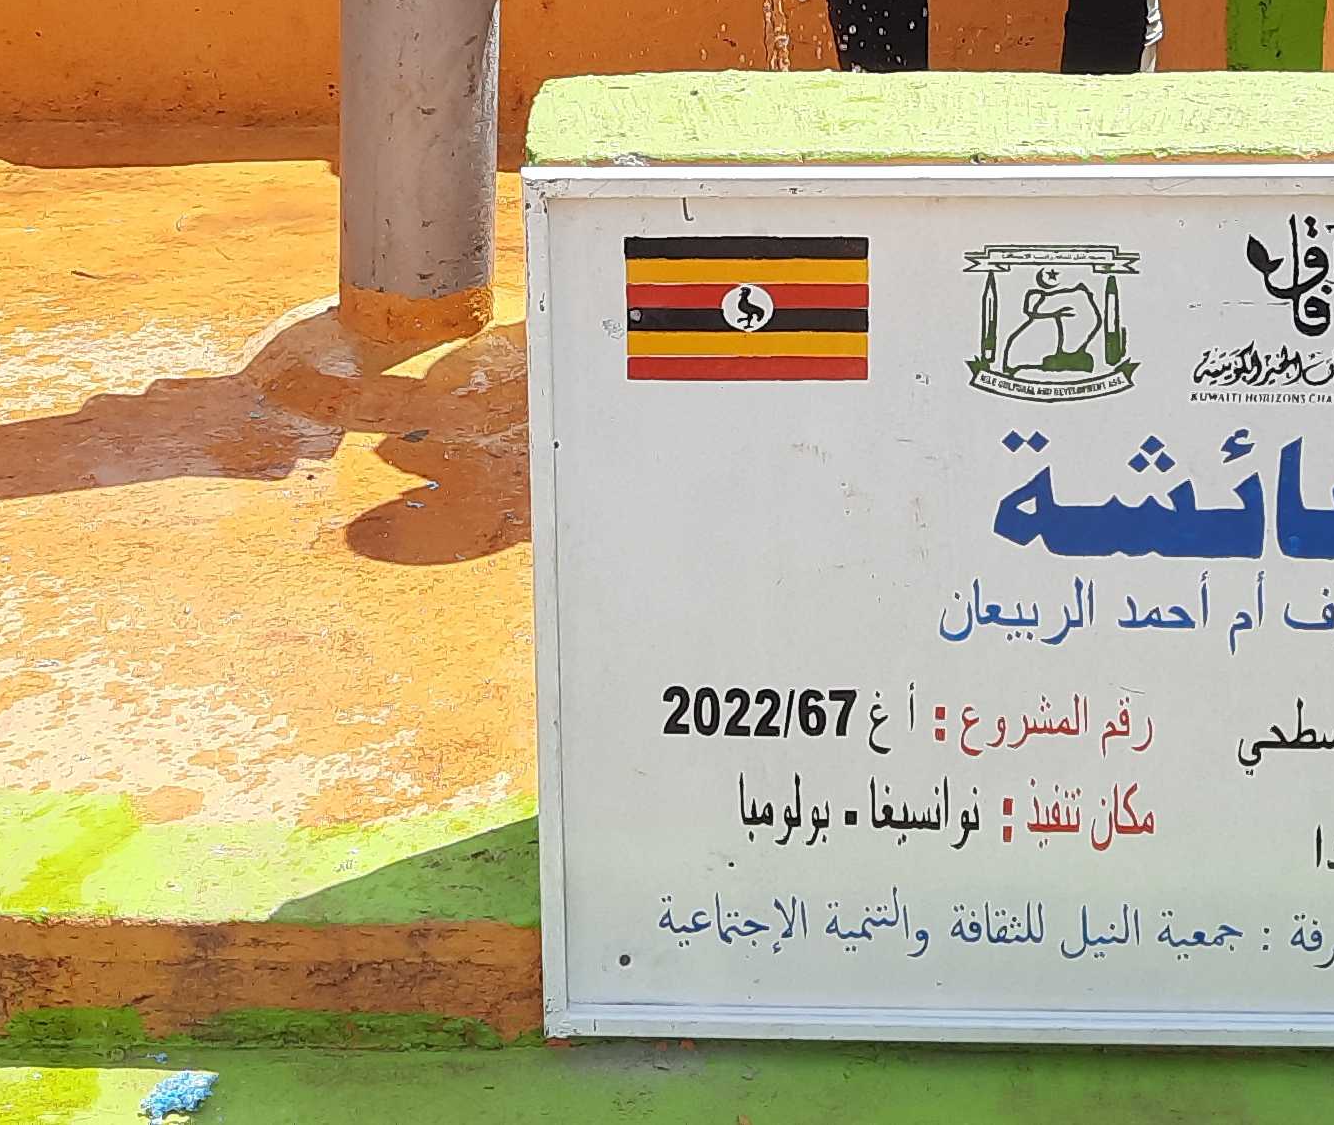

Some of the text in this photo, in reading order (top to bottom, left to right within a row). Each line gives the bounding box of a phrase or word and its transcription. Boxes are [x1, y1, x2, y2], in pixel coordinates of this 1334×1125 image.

[1190, 392, 1242, 405] KUWAITI
[1244, 392, 1306, 405] HORIZONS
[939, 576, 1094, 646] الربيعان
[1117, 570, 1209, 629] أحمد
[1229, 570, 1265, 656] أم
[662, 685, 858, 739] 2022/67
[1101, 696, 1153, 758] رقم
[738, 771, 830, 846] بولومبا
[869, 775, 980, 850] نوانسيغا
[1090, 782, 1155, 852] مكان
[825, 886, 930, 958] والتنمية
[950, 901, 1044, 944] للثقافة
[1060, 903, 1140, 960] النيل
[1157, 910, 1244, 961] جمعية
